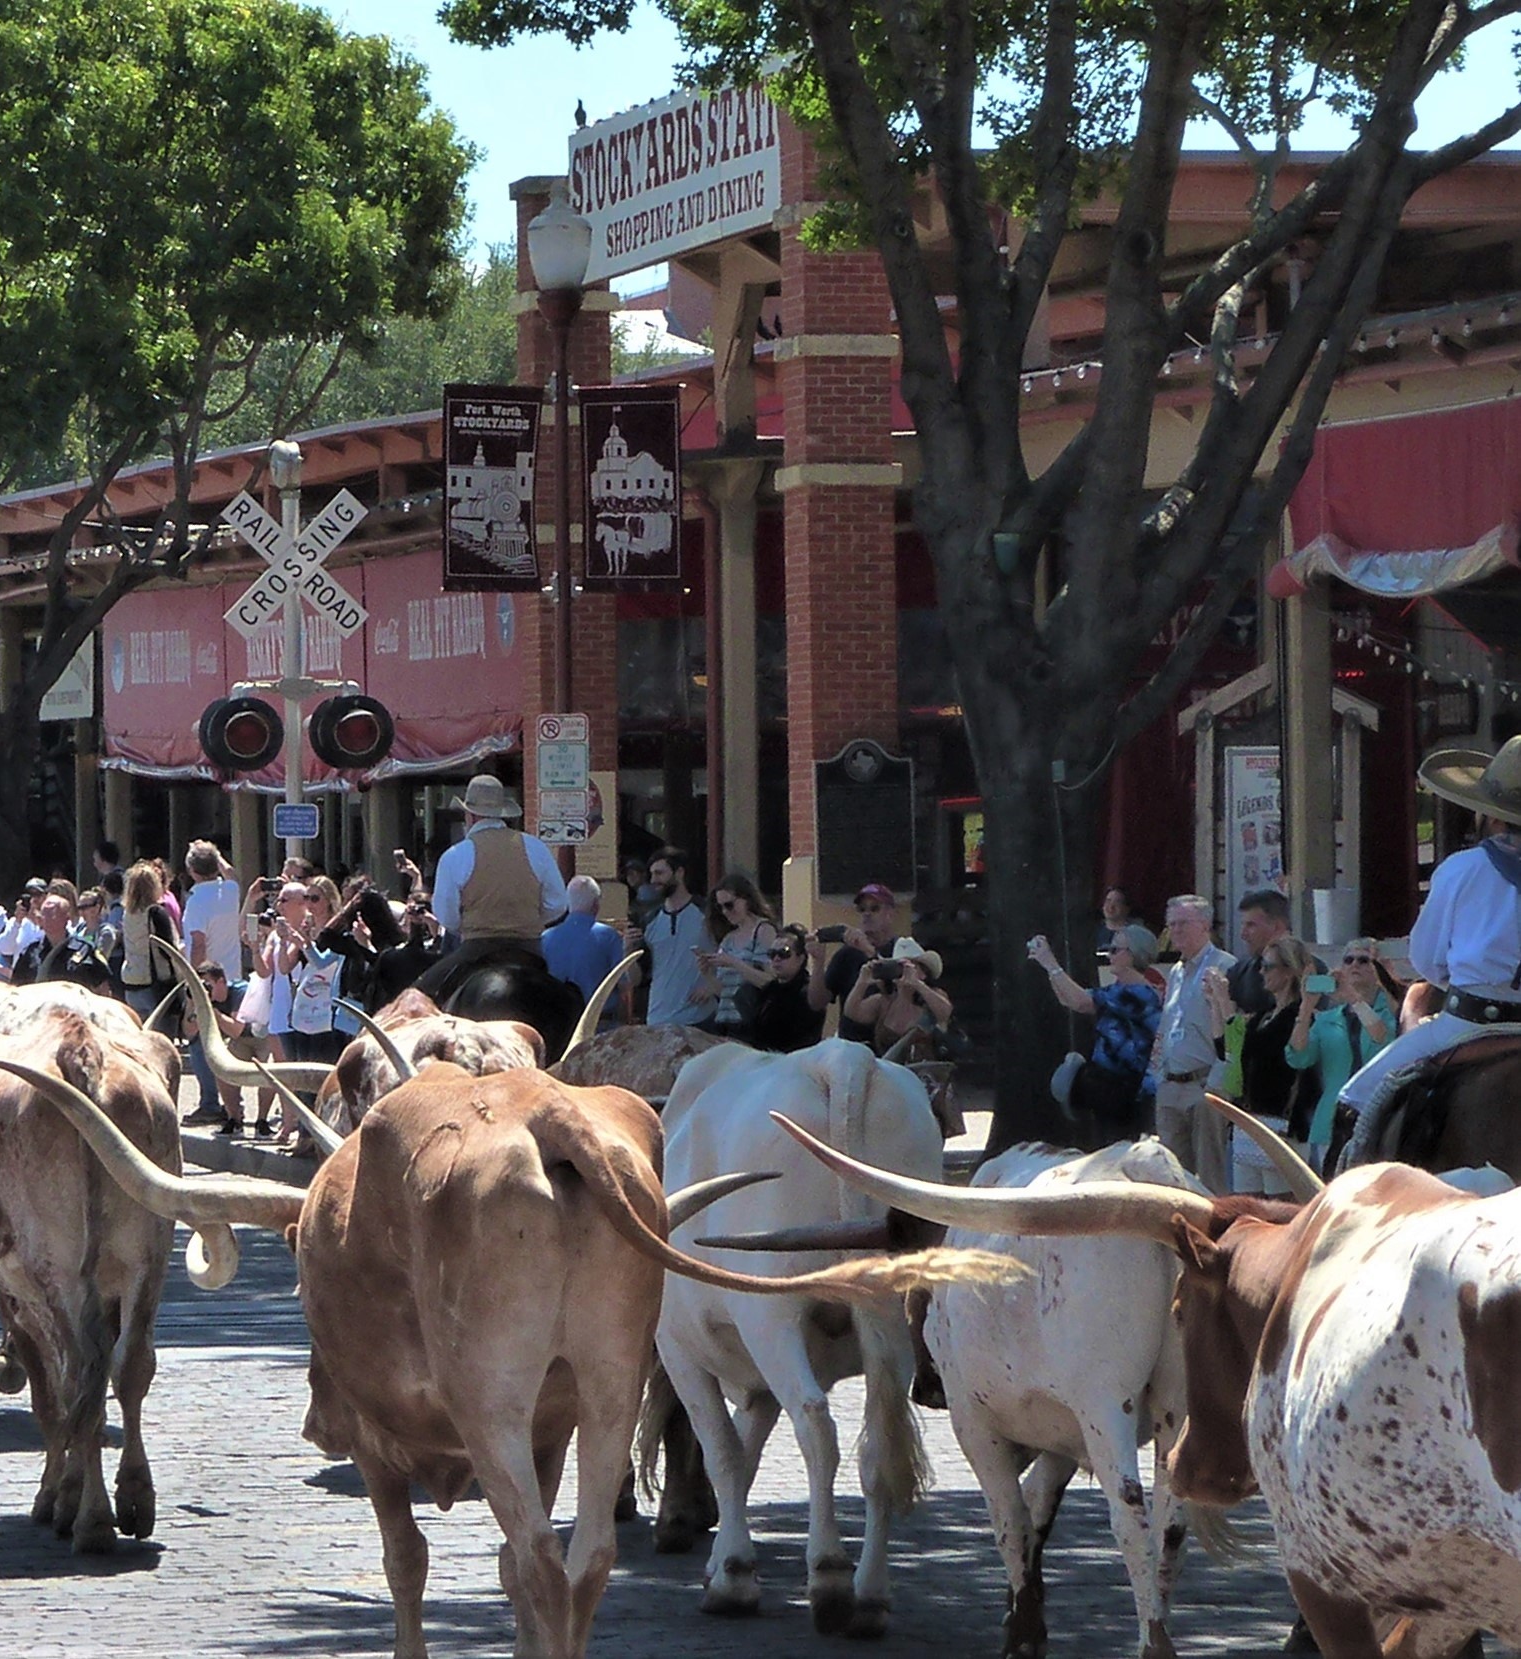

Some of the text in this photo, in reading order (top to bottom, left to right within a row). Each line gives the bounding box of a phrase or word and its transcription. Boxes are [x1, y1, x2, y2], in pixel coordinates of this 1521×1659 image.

[572, 80, 776, 214] STOCKYARDS STATI
[606, 170, 764, 258] SHOPPING AND DINING
[453, 416, 530, 430] STOCKYARDS
[465, 404, 522, 417] Fort Worth
[230, 499, 280, 556] RAIL
[239, 503, 354, 625] CROSSING
[304, 573, 359, 629] ROAD
